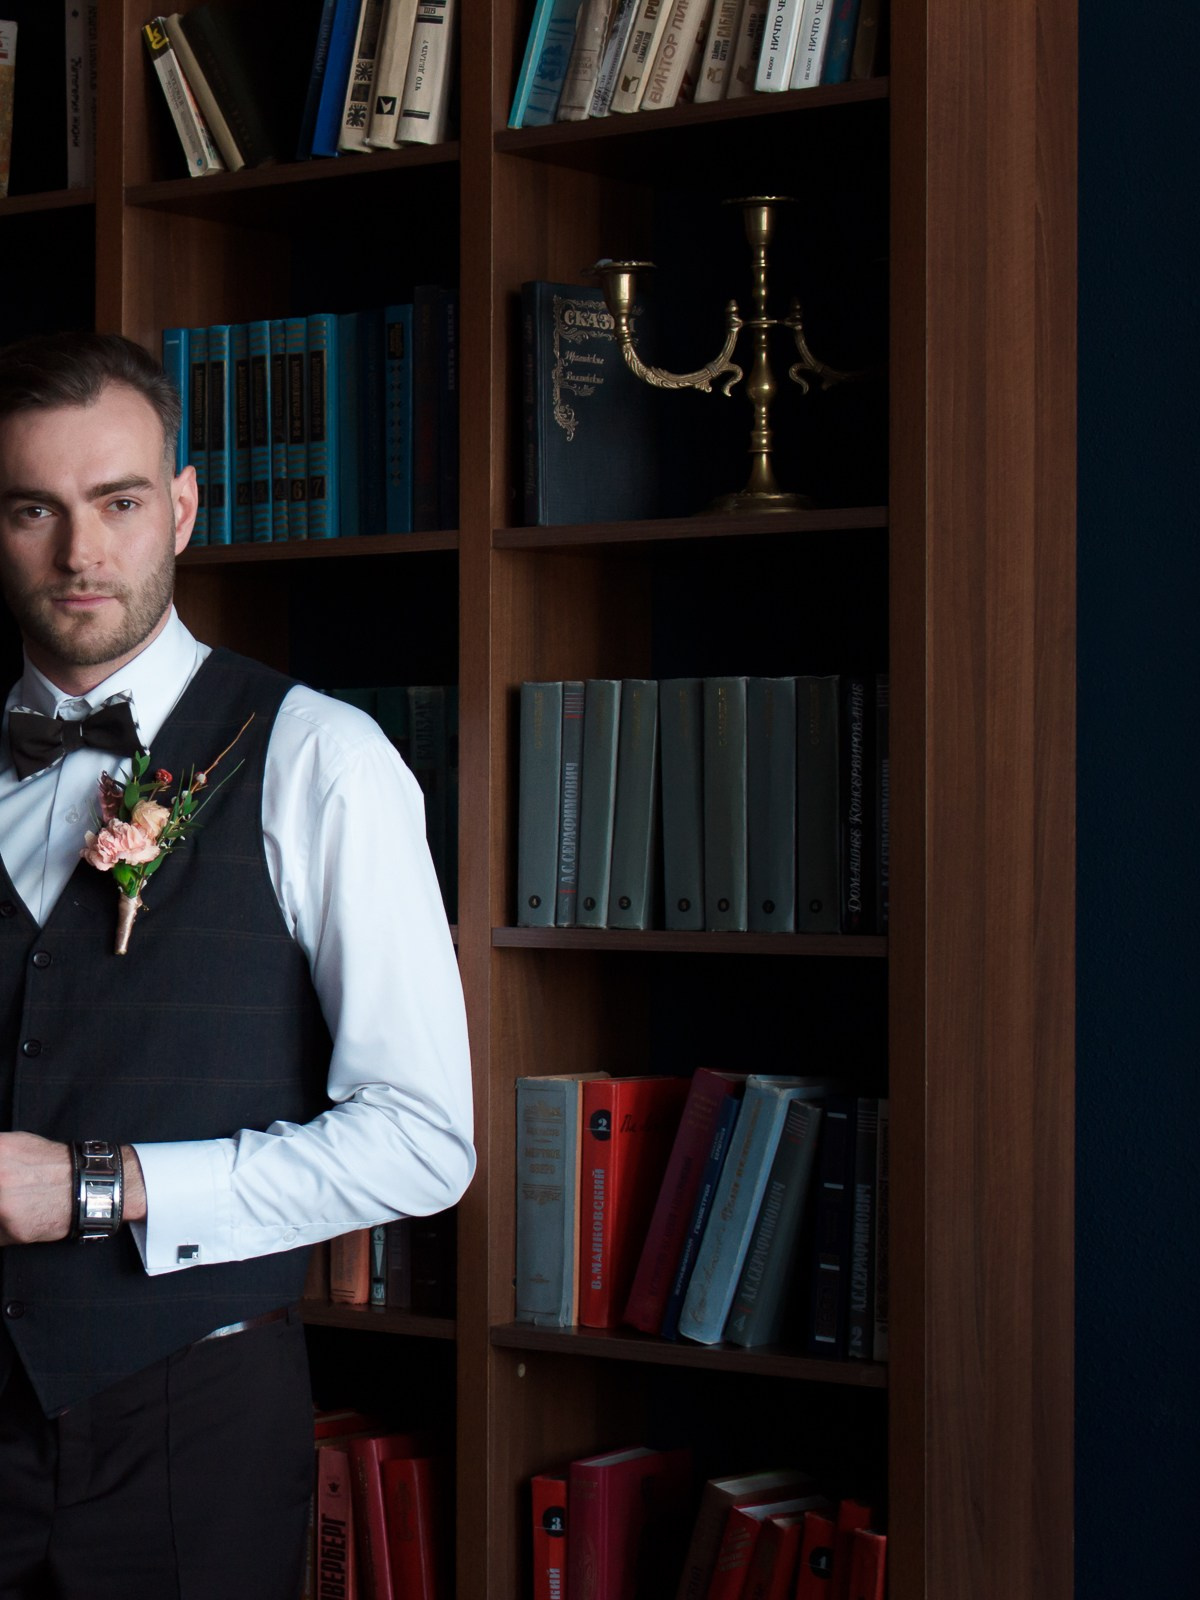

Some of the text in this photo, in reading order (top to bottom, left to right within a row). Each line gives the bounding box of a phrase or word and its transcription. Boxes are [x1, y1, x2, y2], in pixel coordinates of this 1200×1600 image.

[770, 16, 784, 51] НИЧТО
[807, 17, 822, 52] НИЧТО
[414, 76, 423, 91] ЧТО
[292, 483, 303, 500] 6
[312, 478, 322, 497] 7
[596, 1118, 608, 1131] 2
[548, 1515, 561, 1532] 3
